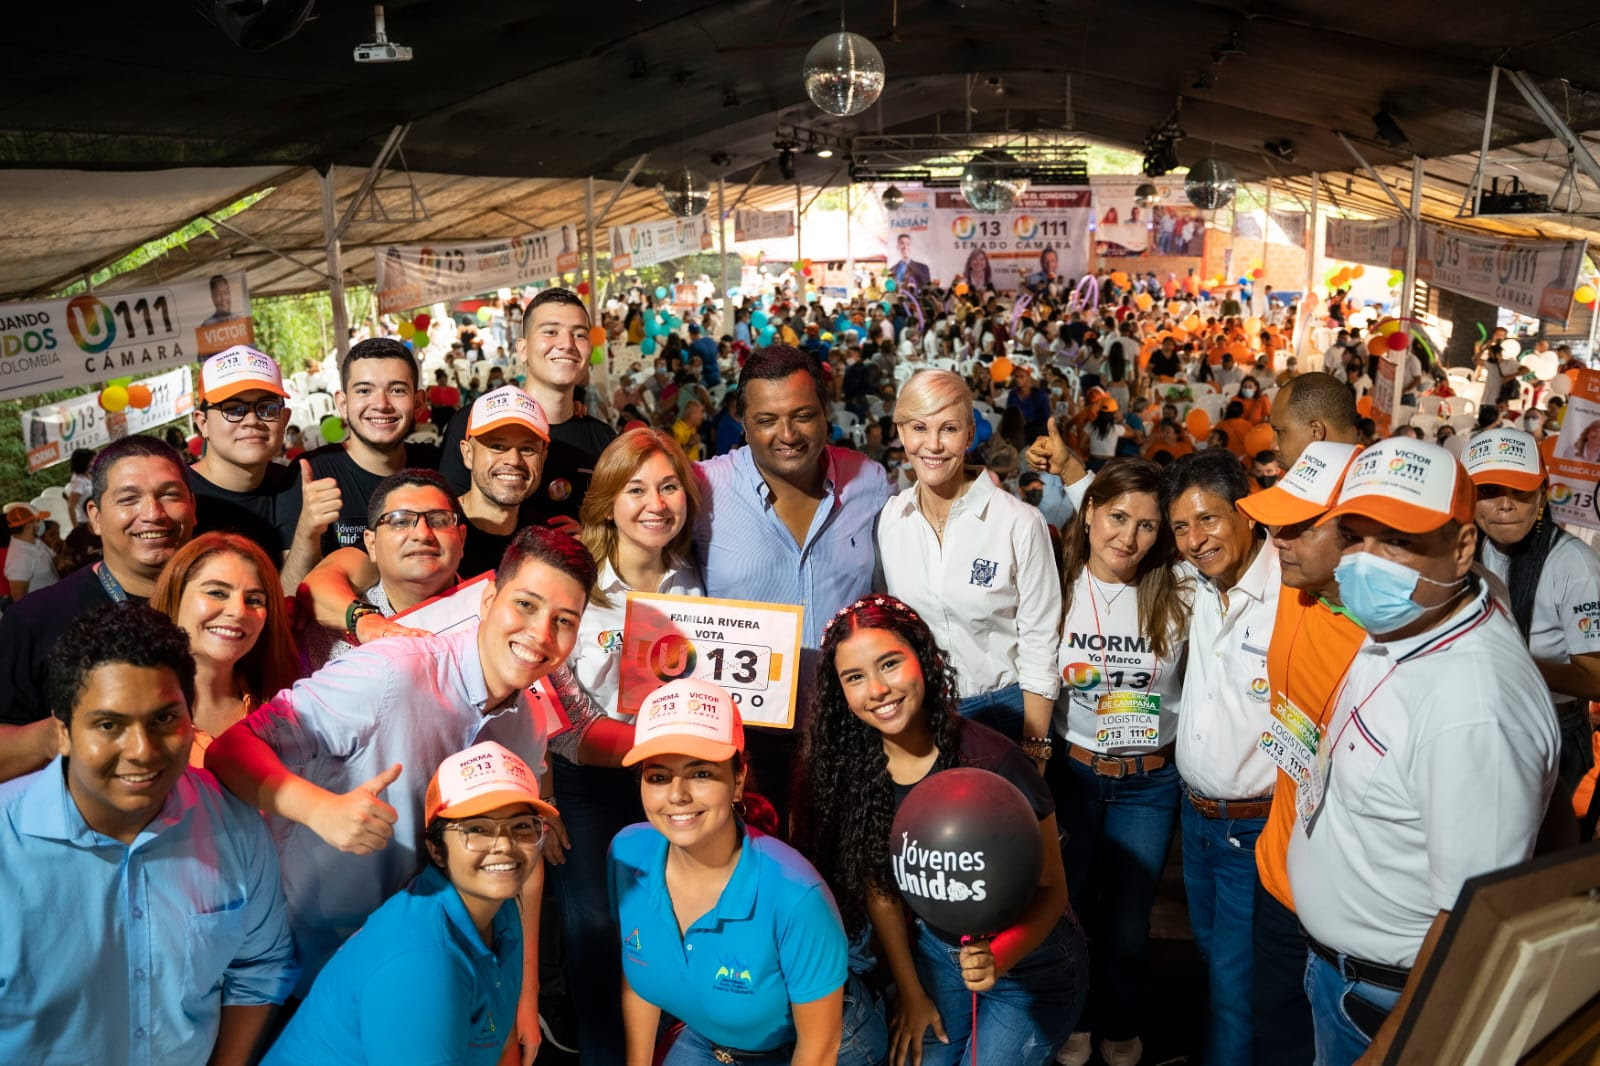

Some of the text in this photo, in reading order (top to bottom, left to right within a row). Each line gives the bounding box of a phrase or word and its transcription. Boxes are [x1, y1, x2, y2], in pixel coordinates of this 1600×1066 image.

[979, 221, 1001, 236] 13
[1040, 221, 1068, 236] 111
[641, 229, 653, 247] 13
[954, 241, 1007, 250] SENADO
[528, 236, 549, 261] 111
[445, 249, 465, 273] 13
[1513, 248, 1539, 284] 111
[114, 295, 174, 339] 111
[204, 323, 247, 345] VICTOR
[0, 328, 57, 357] DOS
[0, 353, 61, 375] OLOMBIA
[85, 342, 184, 373] CÁMARA
[78, 406, 95, 431] 13
[1501, 437, 1526, 447] VICTOR
[1395, 449, 1431, 465] VICTOR
[1511, 446, 1523, 454] 111
[1305, 466, 1318, 477] 111
[1364, 460, 1377, 470] 13
[1406, 463, 1424, 477] 111
[1574, 493, 1592, 508] 13
[1573, 600, 1600, 614] NOR
[670, 613, 760, 630] FAMILIA RIVERA
[695, 630, 725, 641] VOTA
[706, 648, 758, 684] 13
[1088, 653, 1142, 665] Yo Marco
[1109, 671, 1152, 689] 13
[652, 693, 680, 704] NORMA
[689, 692, 719, 703] VICTOR
[662, 702, 676, 711] 13
[702, 703, 716, 713] 111
[1130, 729, 1144, 737] 111
[1274, 743, 1284, 756] 13
[460, 753, 493, 767] NORMA
[477, 762, 492, 770] 13
[1290, 757, 1301, 773] 111
[900, 834, 985, 871] Jóvenes
